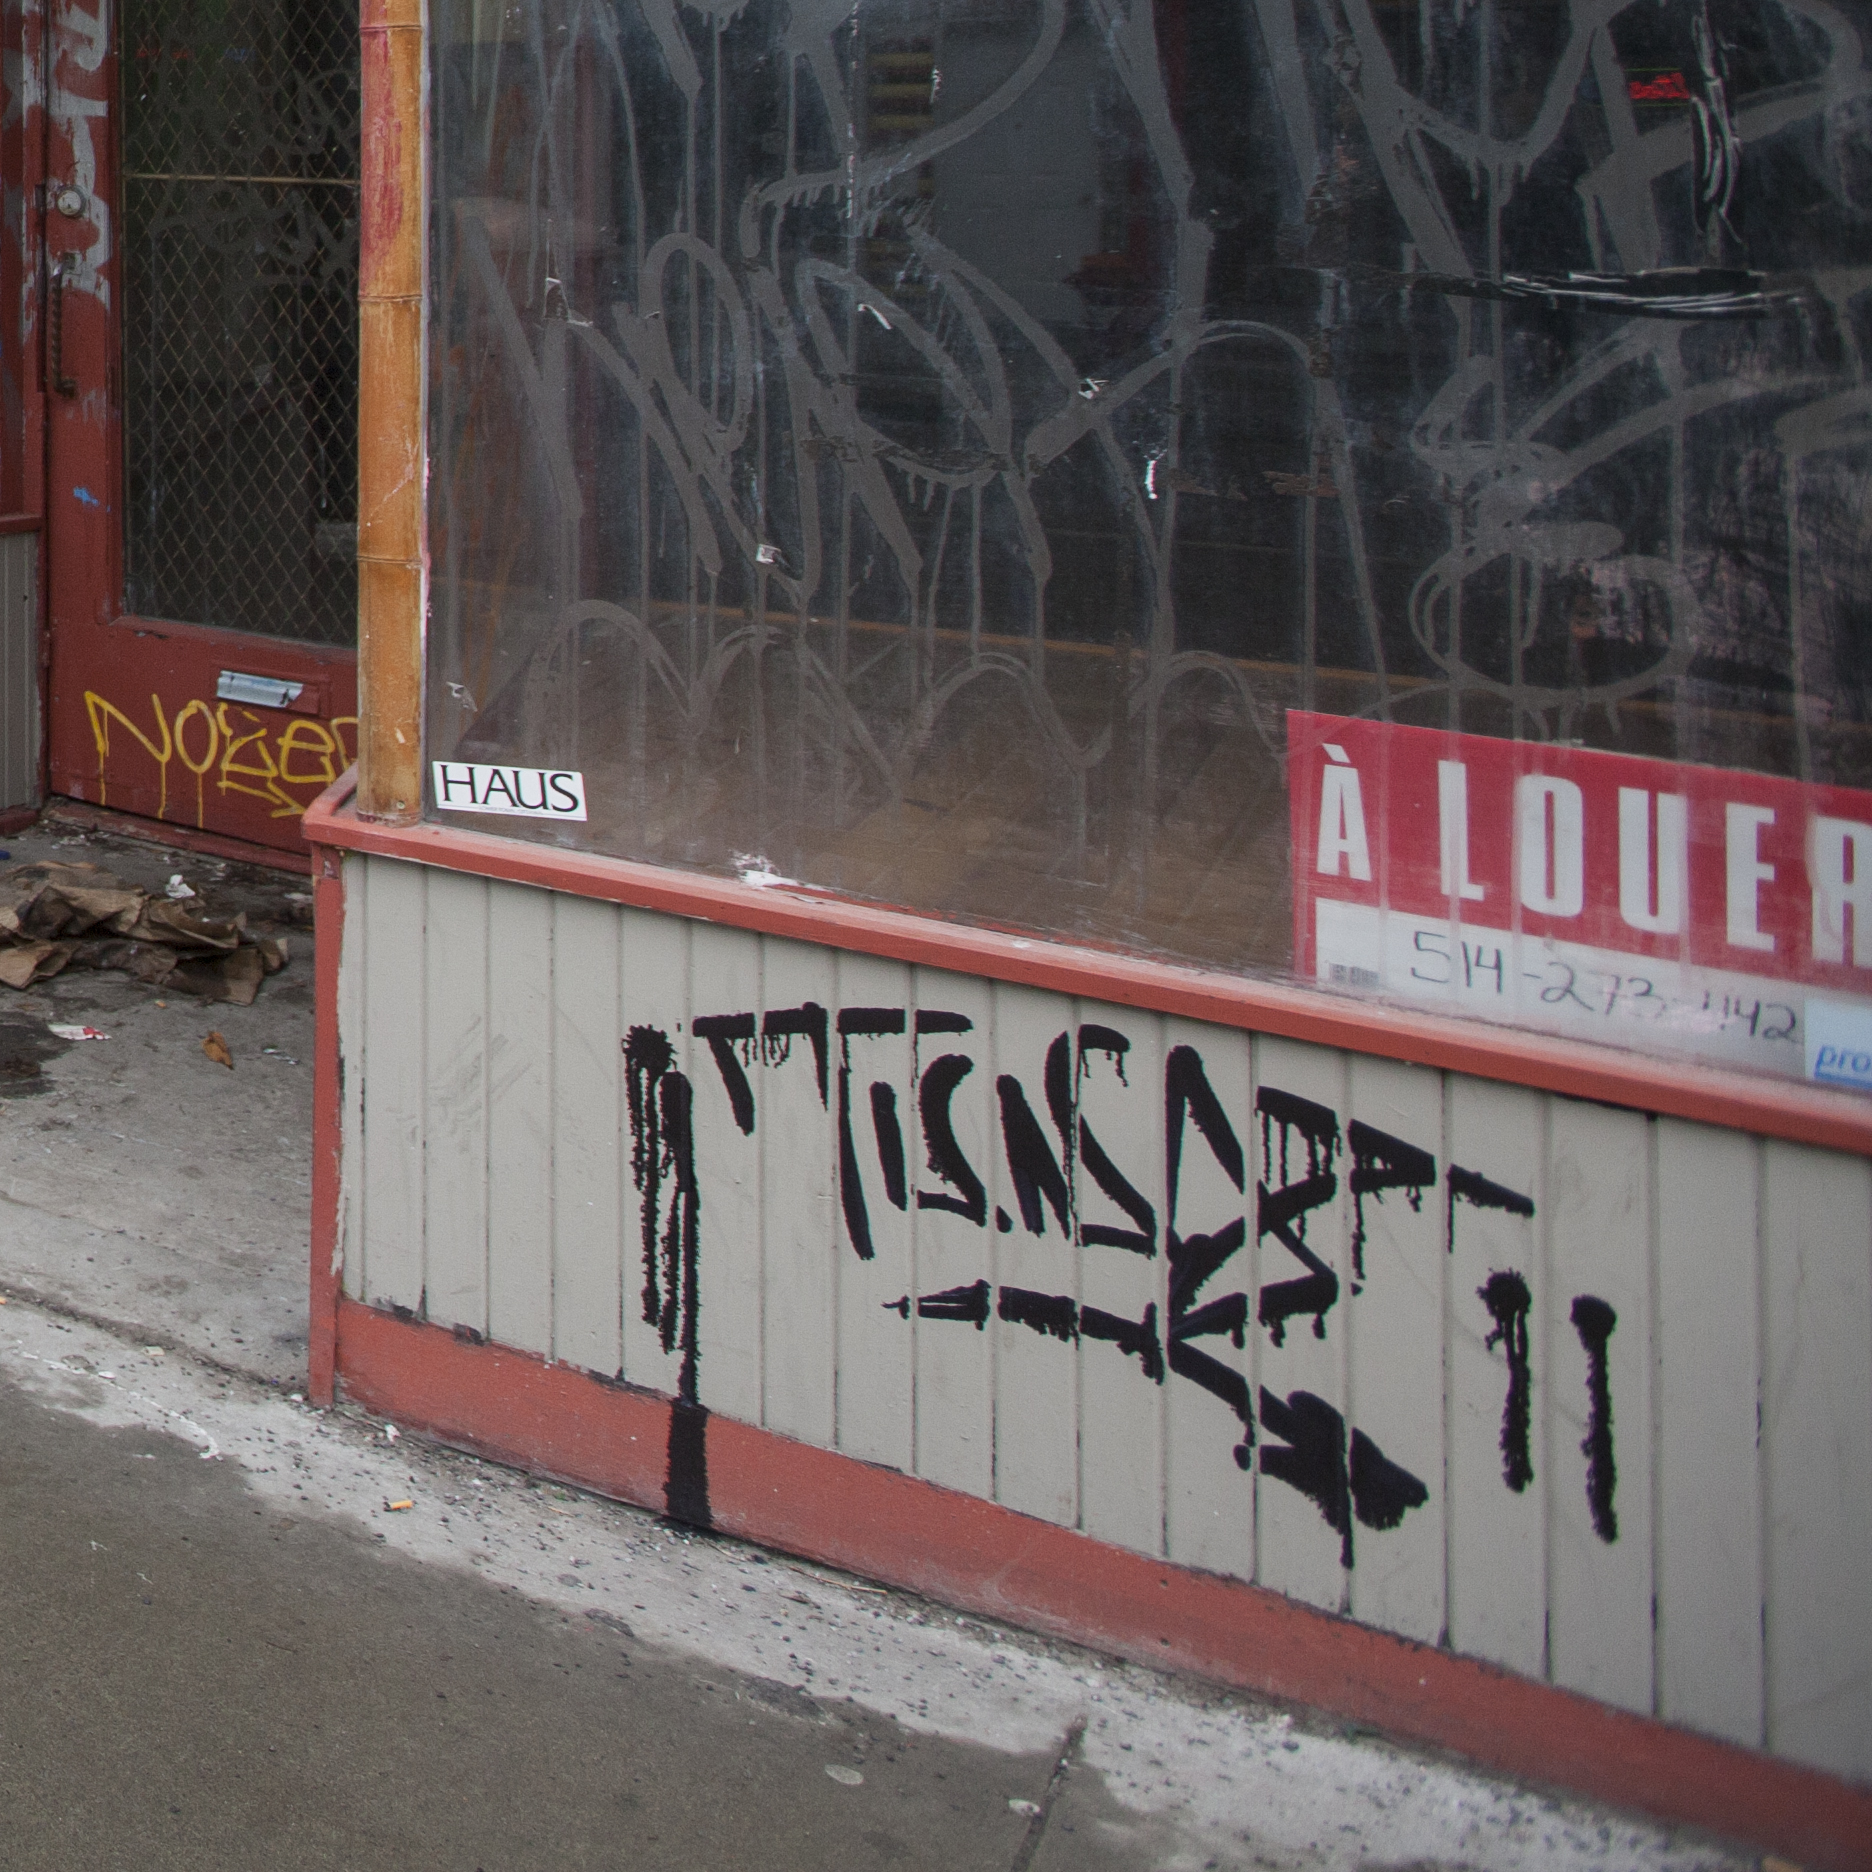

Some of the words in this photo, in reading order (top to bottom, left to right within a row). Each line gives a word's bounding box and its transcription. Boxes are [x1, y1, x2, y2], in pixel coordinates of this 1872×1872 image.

[440, 764, 579, 812] HAUS
[1316, 742, 1372, 882] À
[1437, 759, 1872, 970] LOUER
